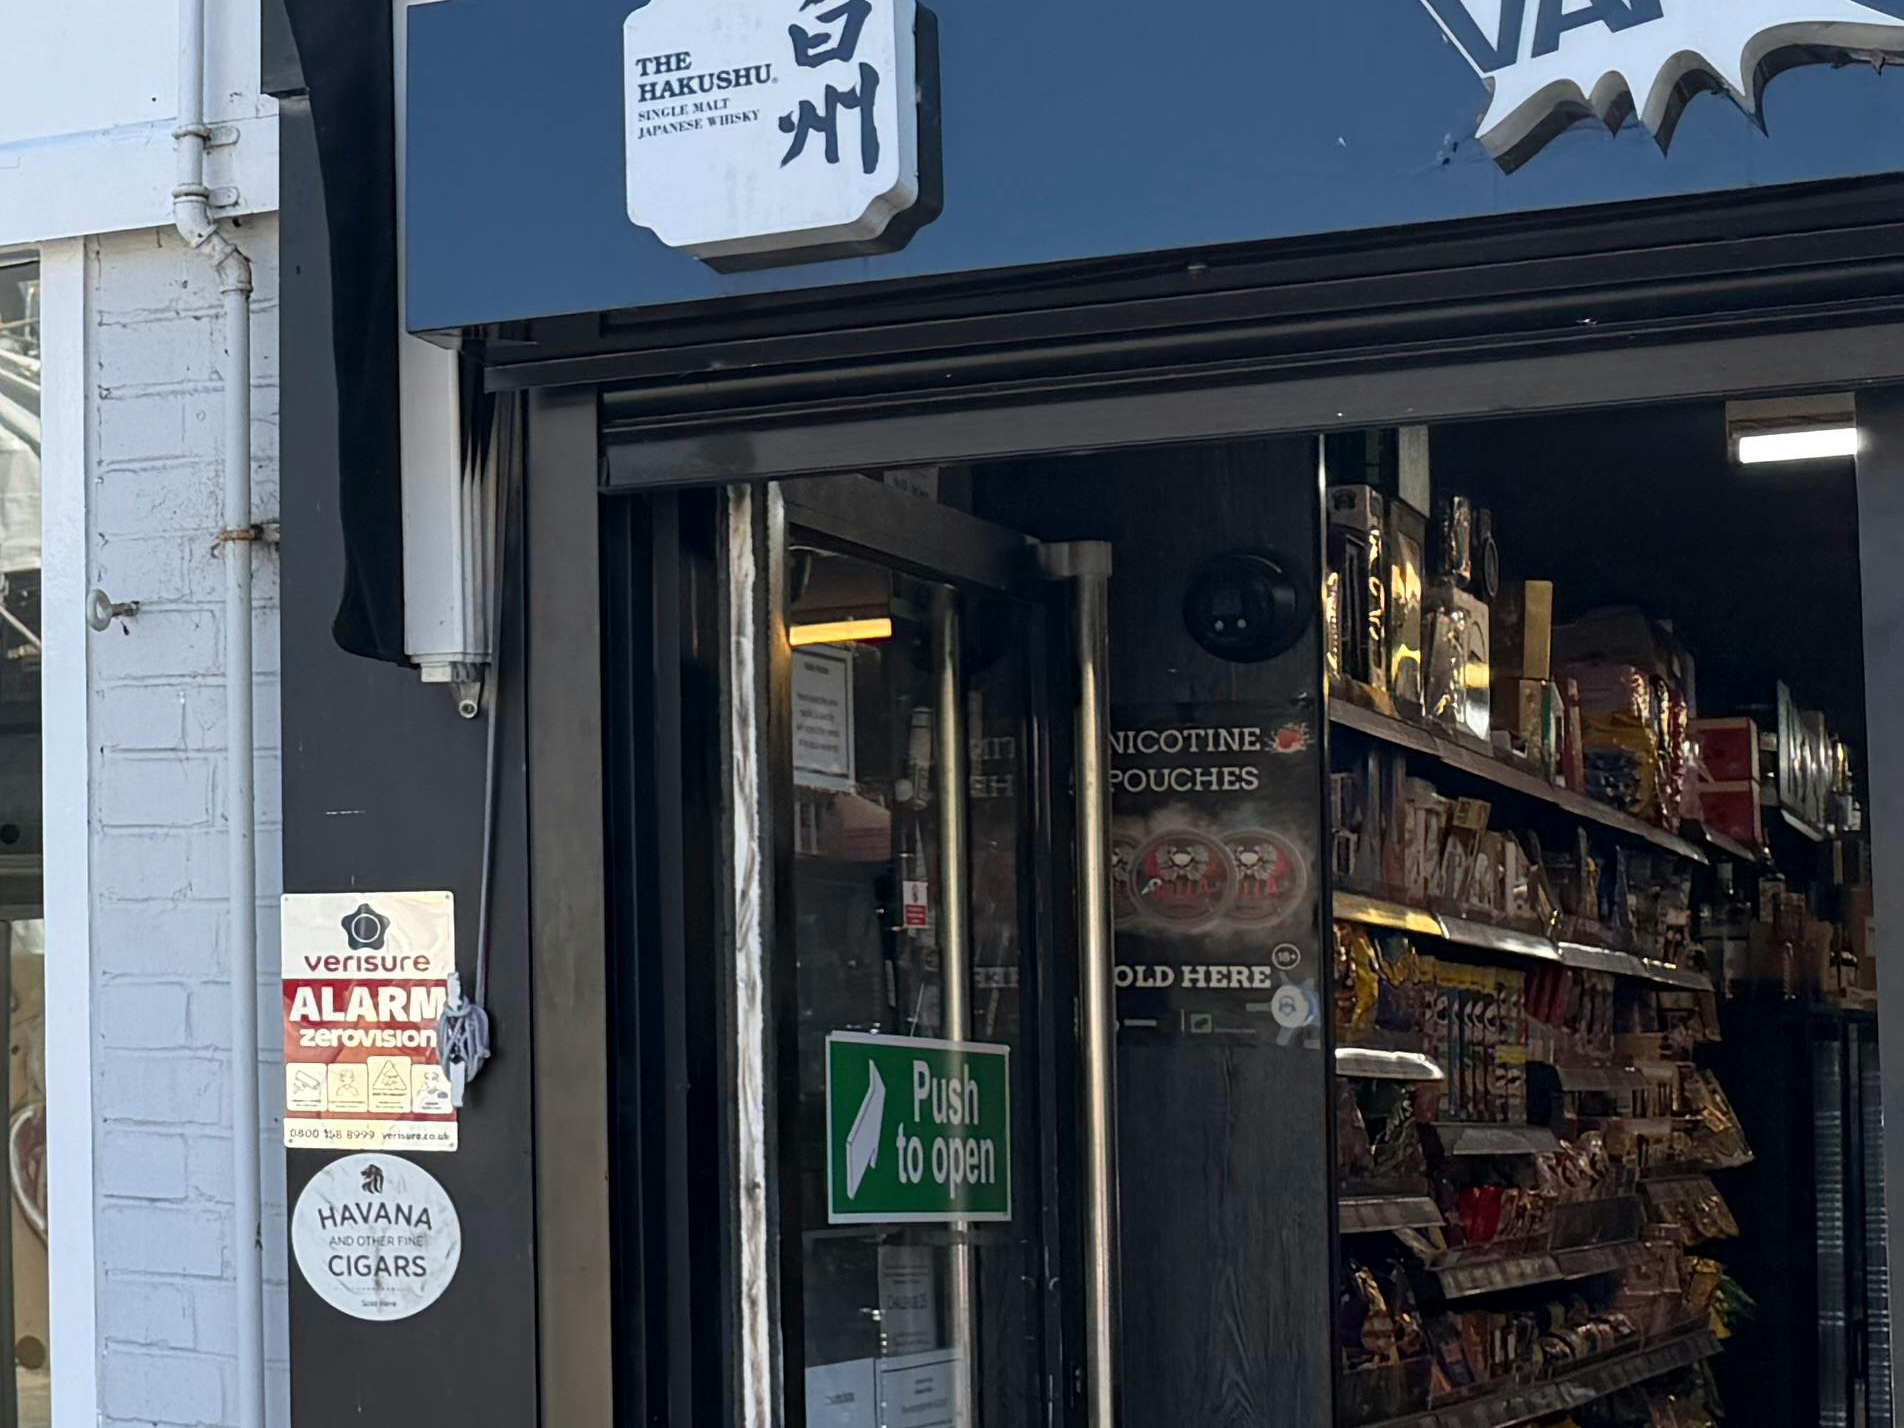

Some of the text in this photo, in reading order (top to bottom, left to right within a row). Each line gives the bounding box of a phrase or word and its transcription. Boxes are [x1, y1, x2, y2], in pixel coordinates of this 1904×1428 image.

[635, 51, 692, 77] THE
[637, 63, 772, 103] HAKUSHU
[637, 97, 730, 123] SINGLE MALT
[637, 109, 760, 140] JAPANESE WHISKY
[1110, 728, 1261, 755] NICOTINE
[1110, 766, 1260, 794] POUCHES
[304, 953, 431, 973] verisure
[1114, 965, 1272, 989] OLD HERE
[288, 985, 448, 1023] ALARM
[299, 1026, 438, 1049] zerovision
[913, 1059, 979, 1125] Push
[289, 1128, 320, 1139] 0800
[896, 1122, 995, 1200] to open
[317, 1201, 433, 1231] HAVANA
[329, 1234, 424, 1247] AND OTHER FINE
[328, 1254, 428, 1278] CIGARS
